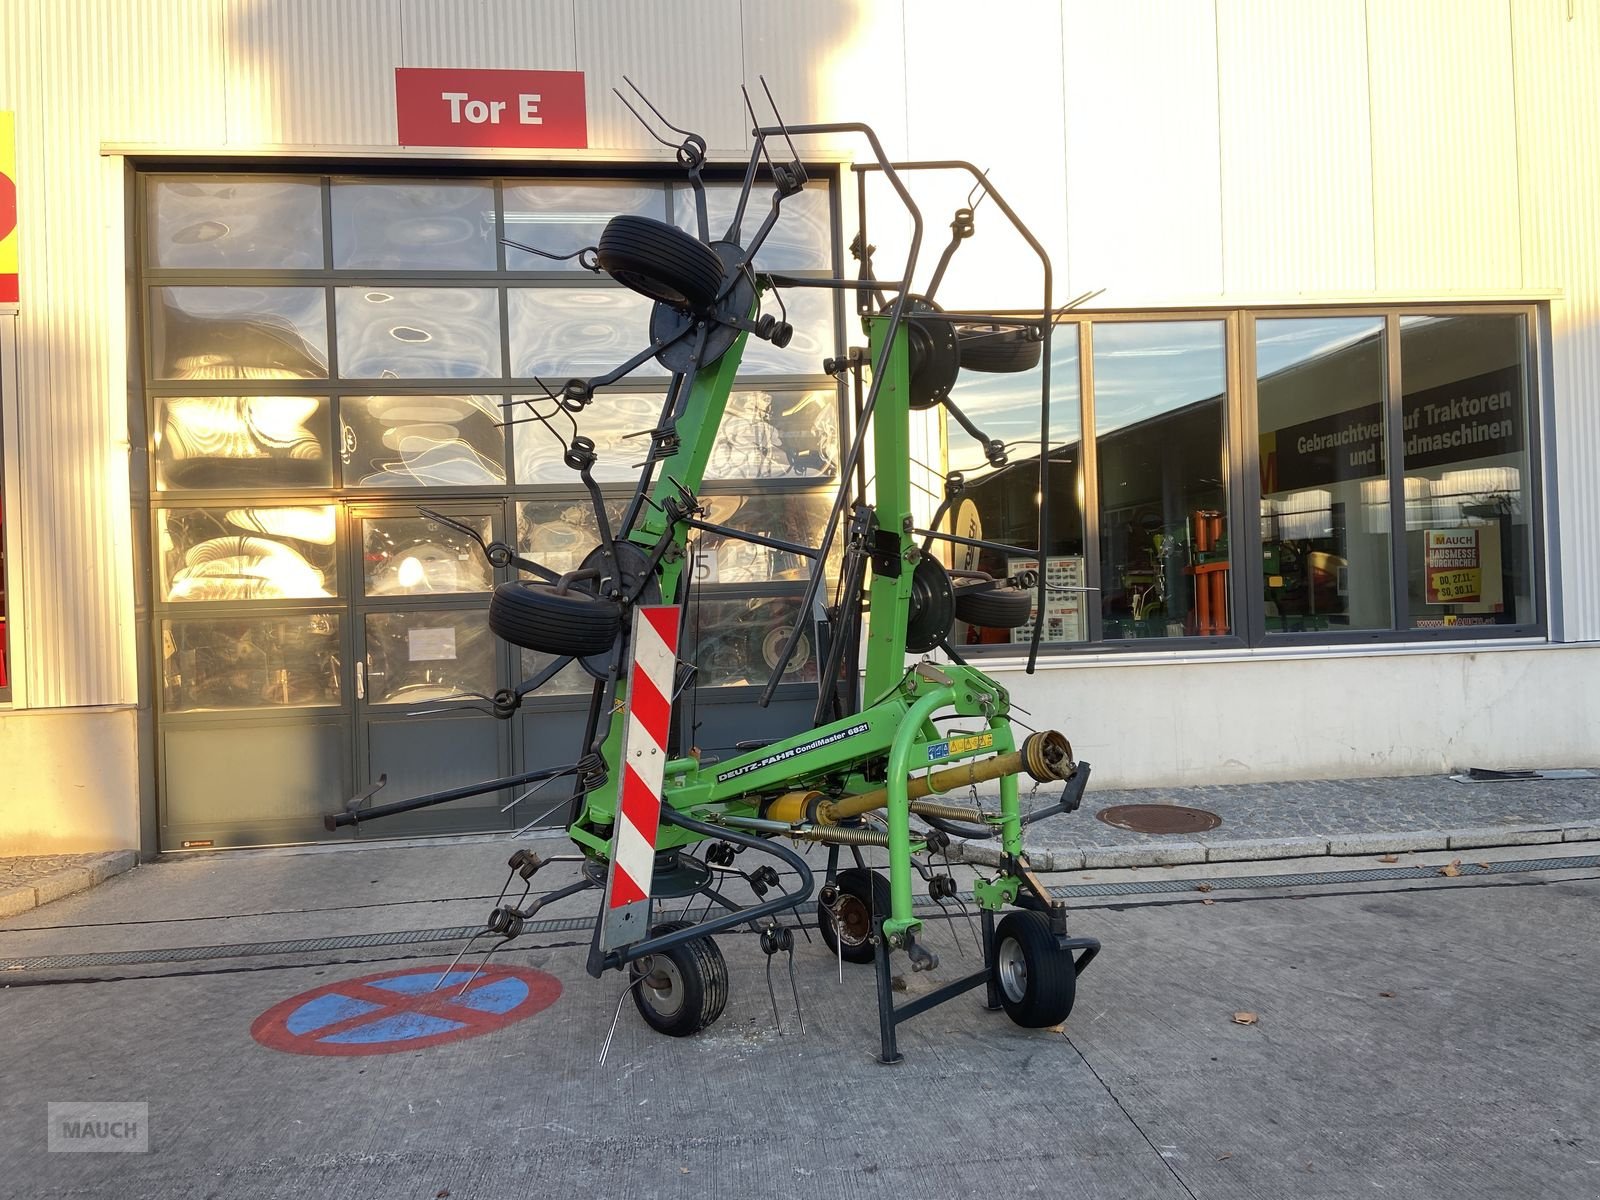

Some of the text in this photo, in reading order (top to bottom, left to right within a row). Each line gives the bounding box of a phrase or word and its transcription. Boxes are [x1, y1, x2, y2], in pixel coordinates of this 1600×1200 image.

[441, 92, 543, 125] Tor E
[1297, 390, 1512, 455] Gebrauchtveruf Traktoren
[1349, 443, 1375, 466] und
[1436, 536, 1473, 545] MAUCH
[1429, 548, 1476, 559] HAUSMESSE
[1429, 558, 1477, 568] BURGKIRCHEN
[694, 554, 711, 580] 5
[718, 723, 869, 782] DEUTZ-FAHR CondiMaster 6821
